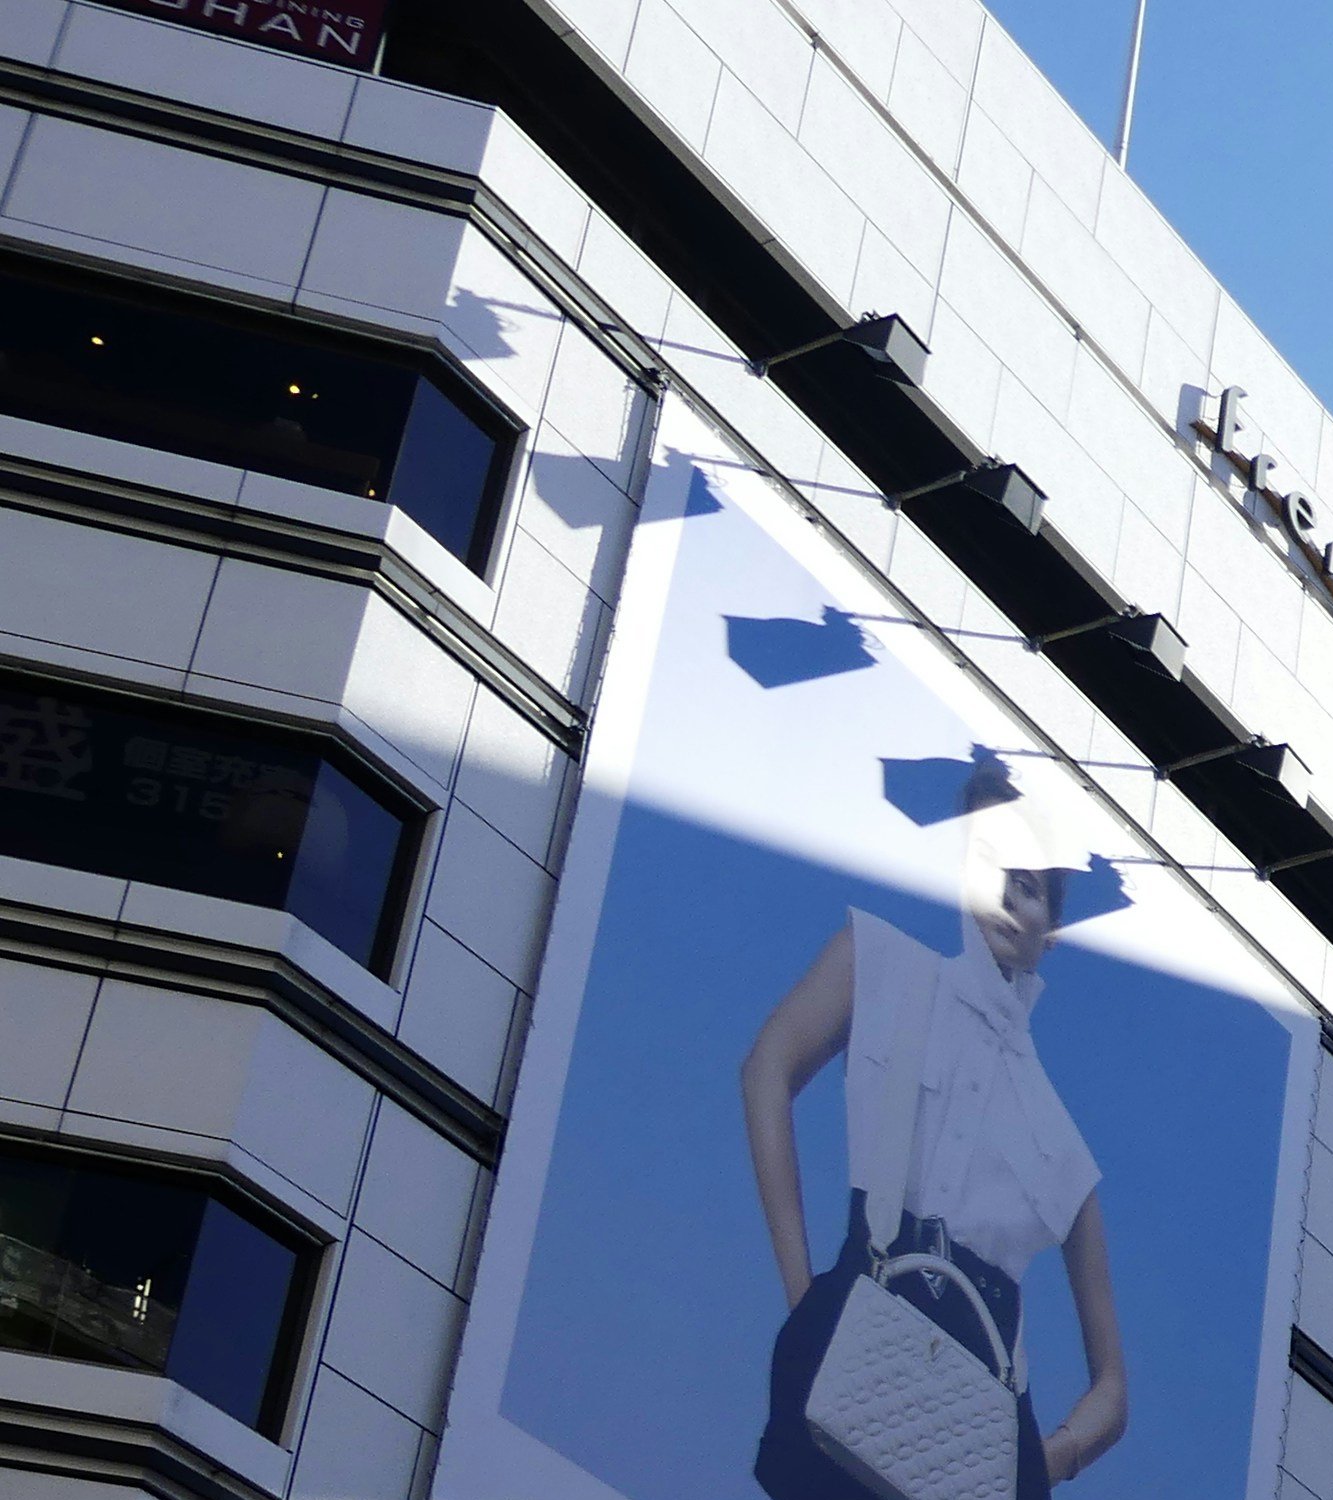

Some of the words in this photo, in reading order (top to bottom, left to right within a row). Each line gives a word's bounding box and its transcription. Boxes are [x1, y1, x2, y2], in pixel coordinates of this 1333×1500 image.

[149, 0, 362, 55] HAN
[254, 0, 366, 29] INING
[122, 736, 304, 795] 個室充
